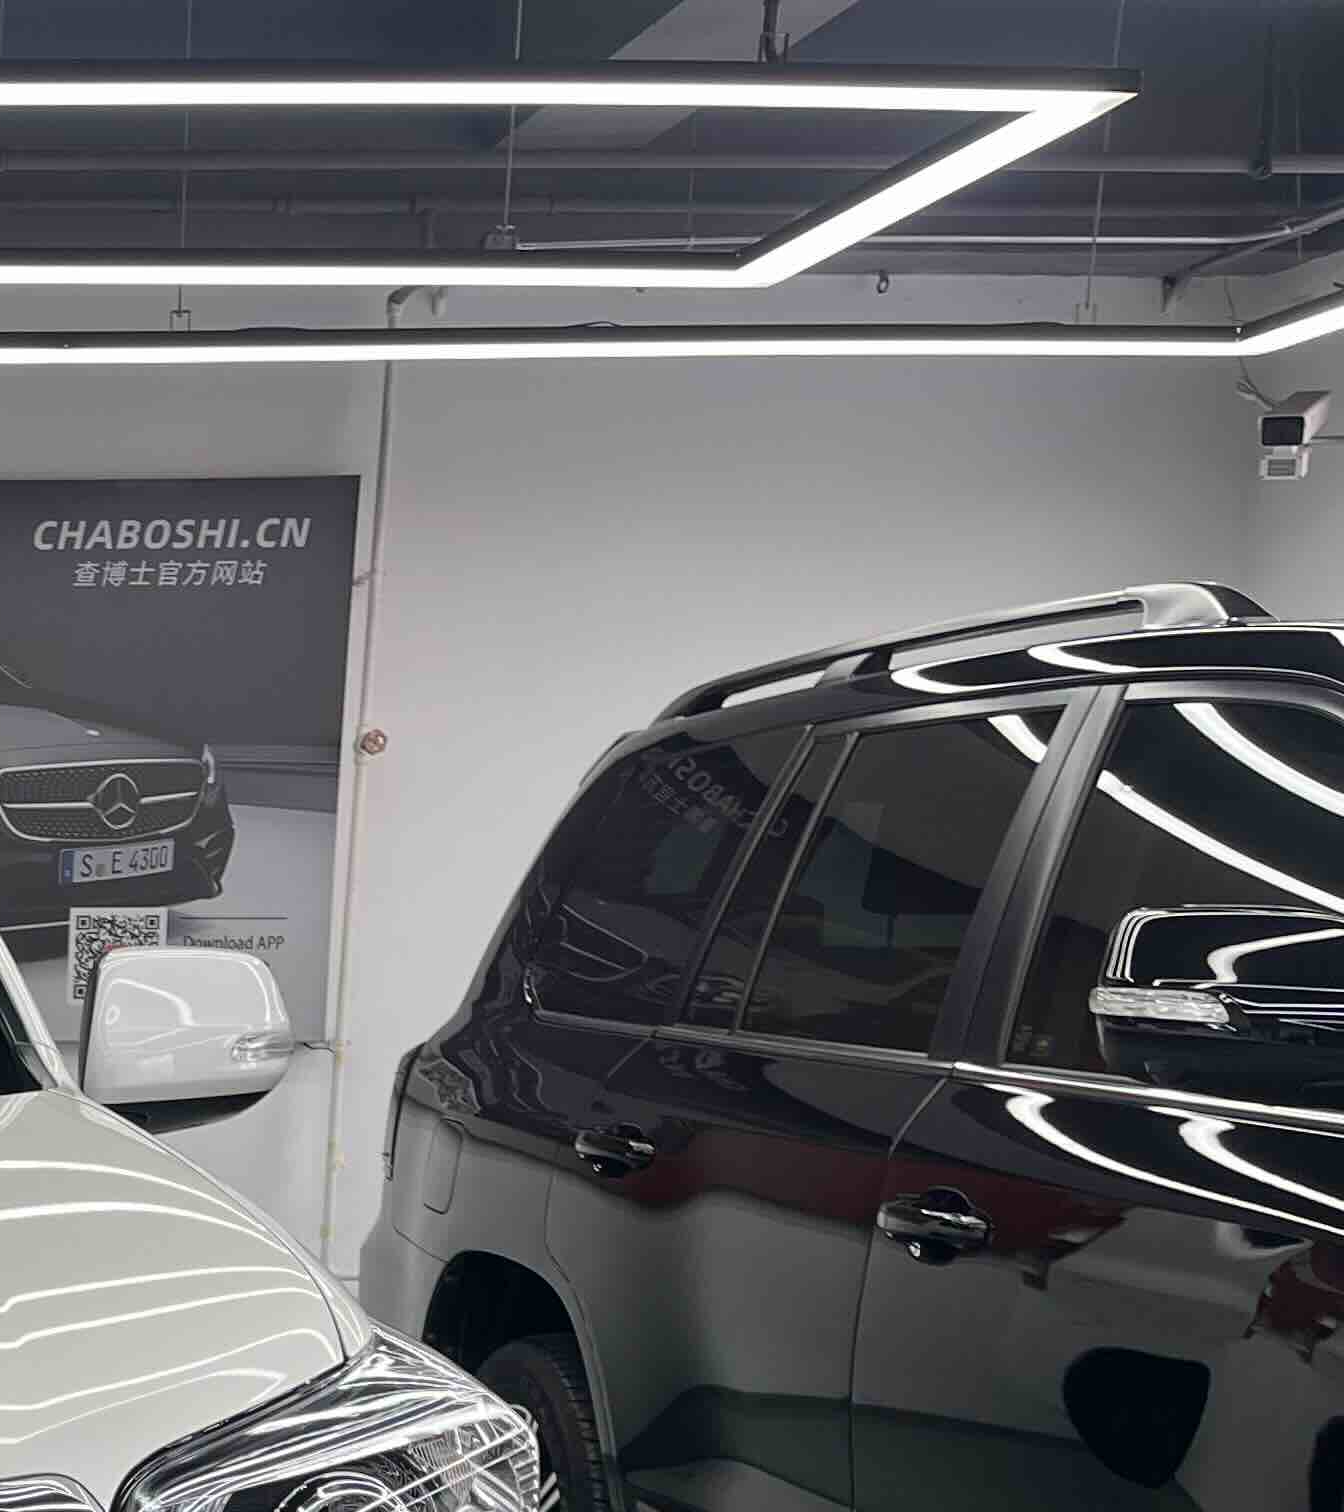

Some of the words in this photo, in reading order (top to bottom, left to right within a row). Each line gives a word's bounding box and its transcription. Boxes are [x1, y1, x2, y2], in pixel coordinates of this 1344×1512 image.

[32, 517, 313, 550] CHABOSHI.CN
[71, 559, 268, 587] 查博士官方网站
[257, 936, 286, 951] APP
